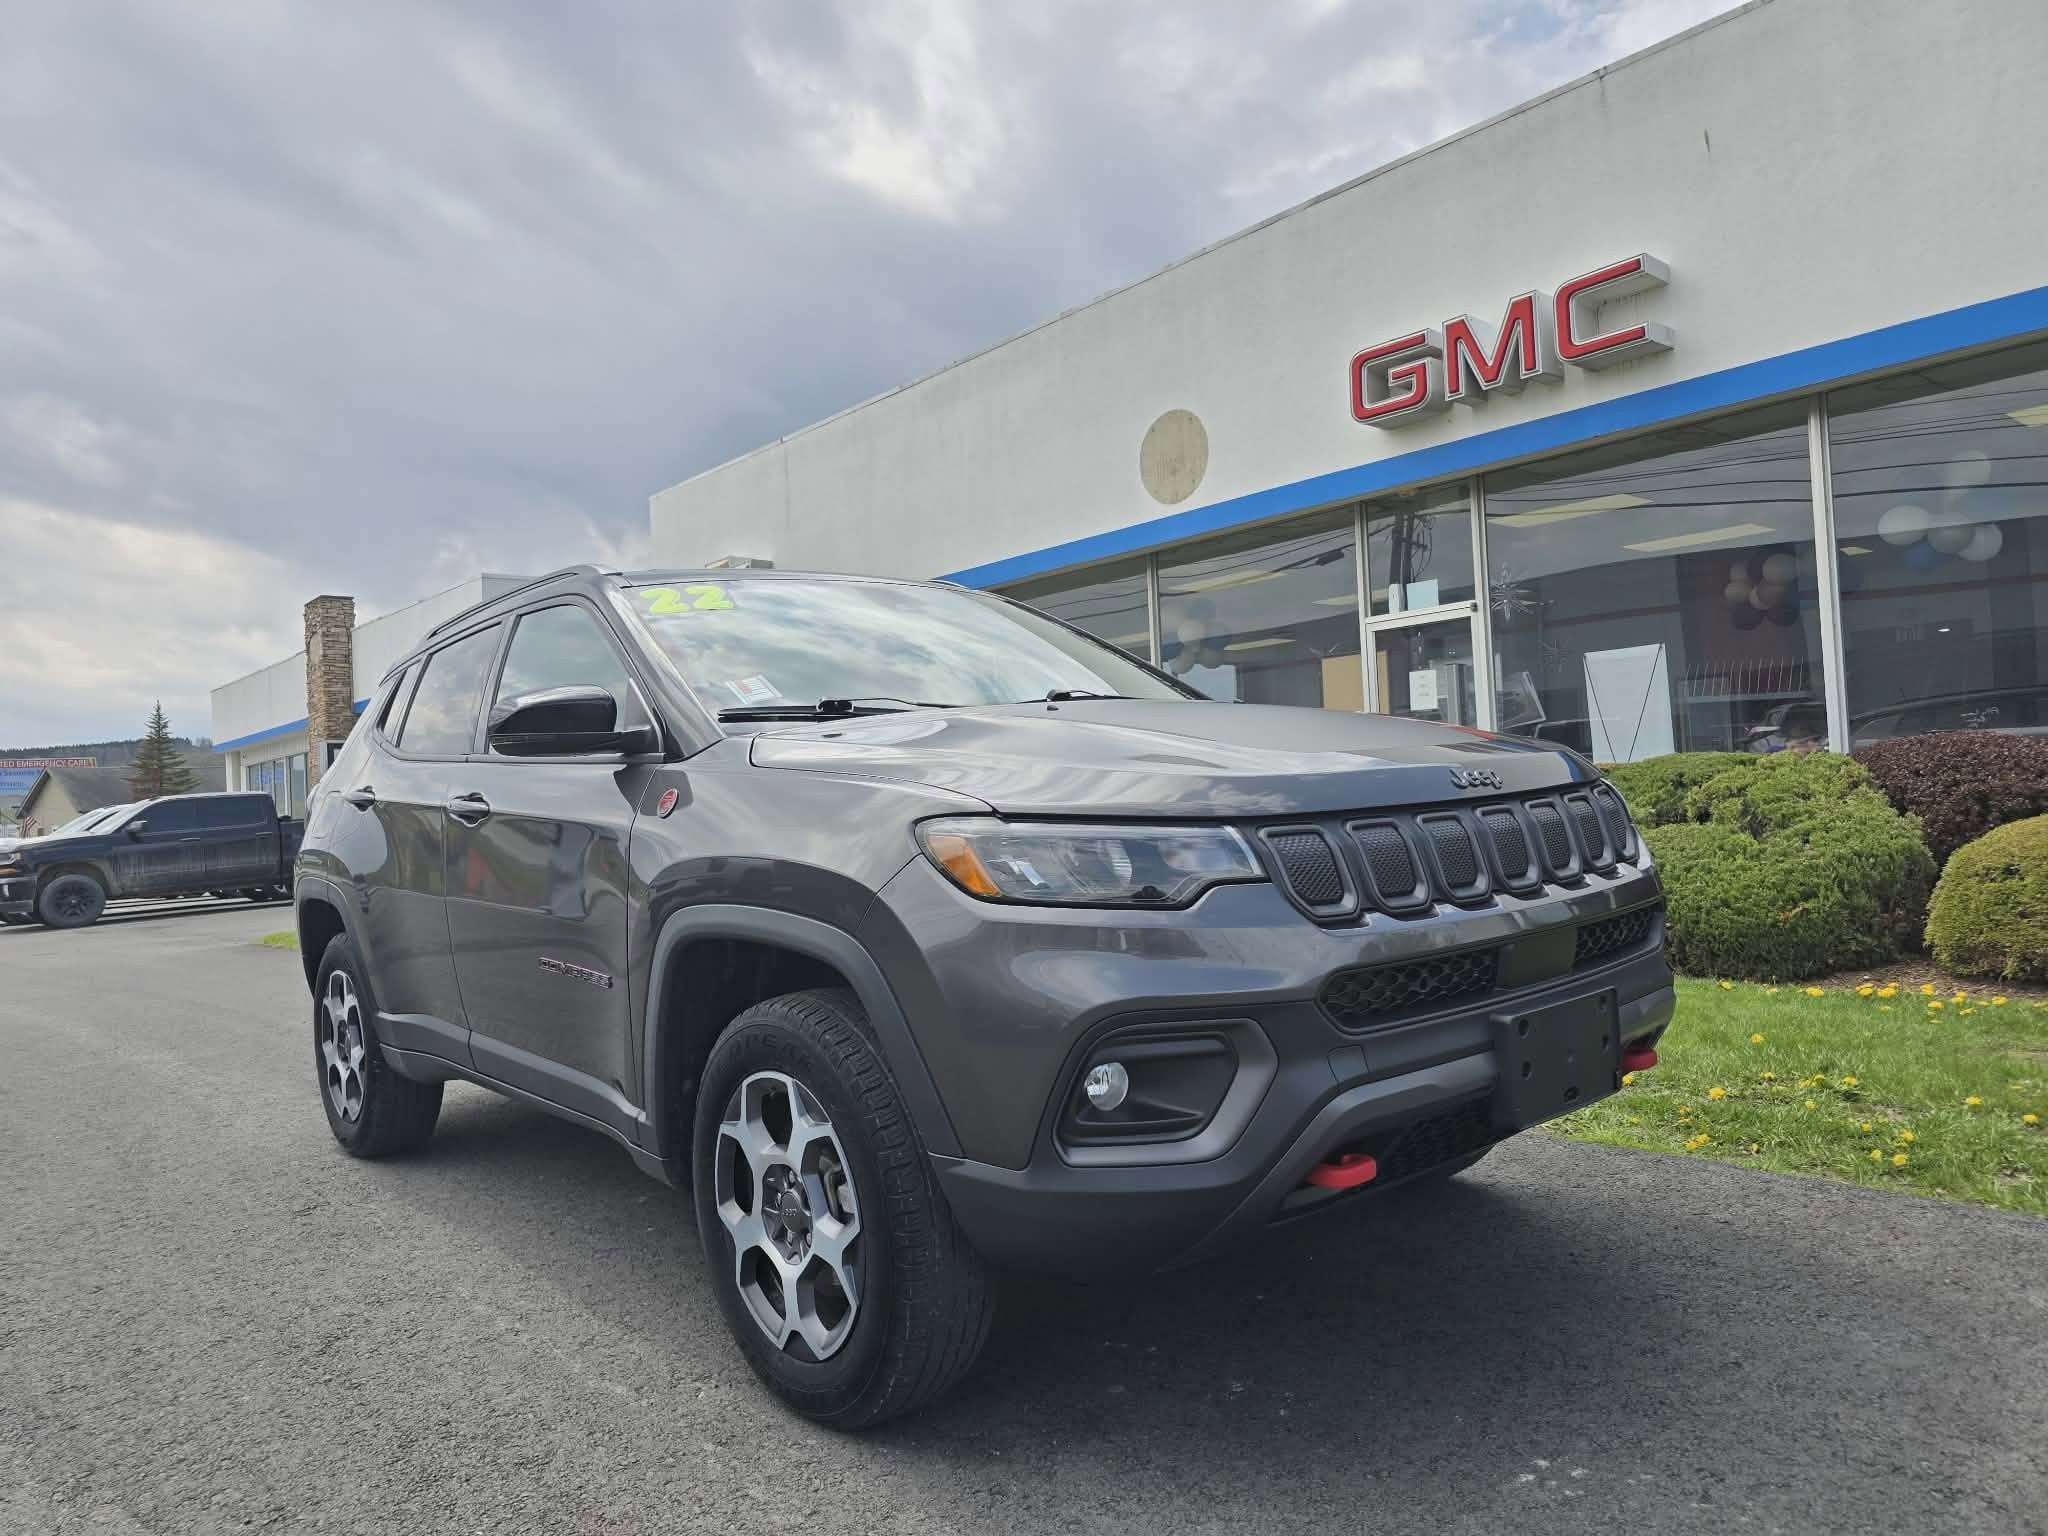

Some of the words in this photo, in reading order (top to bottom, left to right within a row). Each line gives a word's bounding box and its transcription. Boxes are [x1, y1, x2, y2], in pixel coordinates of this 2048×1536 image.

[1349, 253, 1671, 427] GMC
[640, 585, 734, 615] 22
[16, 759, 66, 768] EMERGENCY
[67, 759, 89, 768] CARE
[1449, 767, 1504, 790] Jeep
